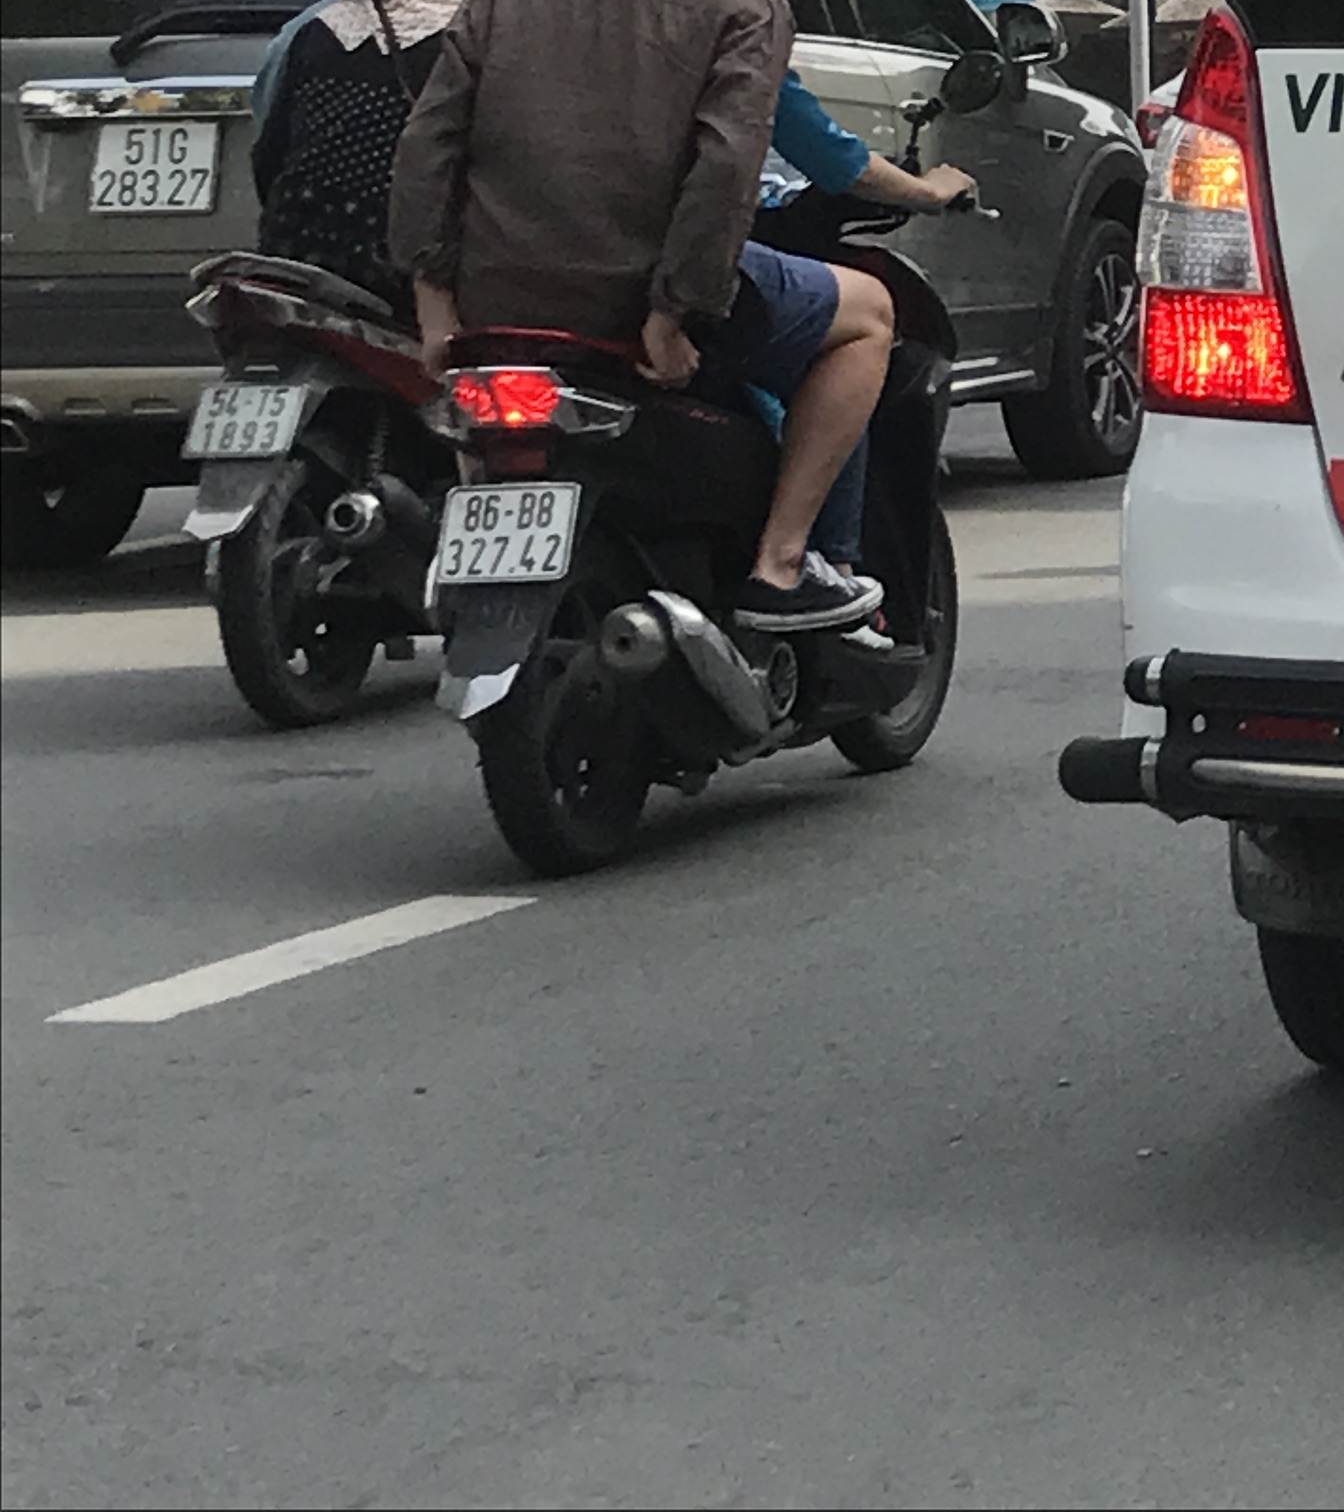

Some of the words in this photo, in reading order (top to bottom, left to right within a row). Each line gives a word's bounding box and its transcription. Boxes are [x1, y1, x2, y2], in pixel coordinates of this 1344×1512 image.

[125, 128, 189, 165] 51G
[204, 421, 278, 451] 1893
[464, 491, 555, 531] 86-B8
[446, 533, 561, 575] 327.42
